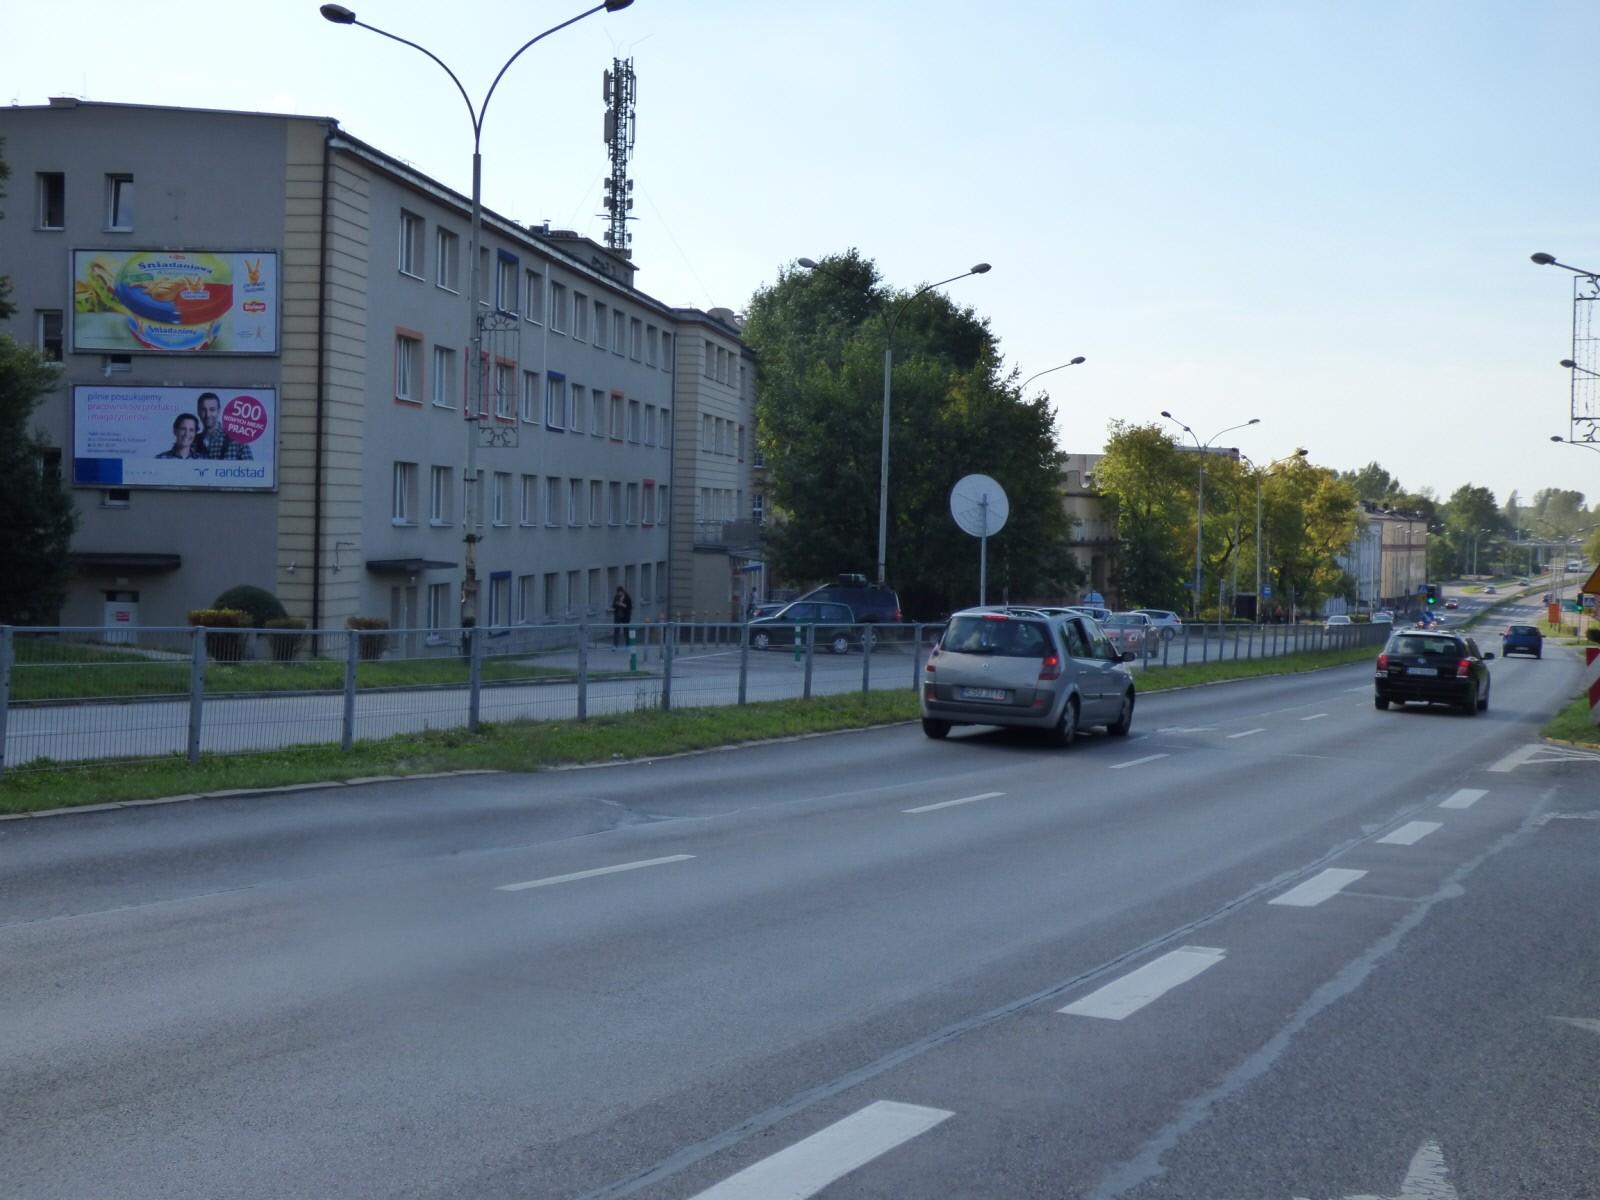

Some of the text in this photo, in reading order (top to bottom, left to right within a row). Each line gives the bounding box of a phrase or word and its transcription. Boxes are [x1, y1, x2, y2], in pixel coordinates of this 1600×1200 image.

[87, 392, 162, 402] pilnie poszukujemy
[231, 400, 262, 421] 500
[223, 415, 247, 425] NOWYCH
[228, 423, 257, 437] PRACY
[215, 466, 265, 478] randstad
